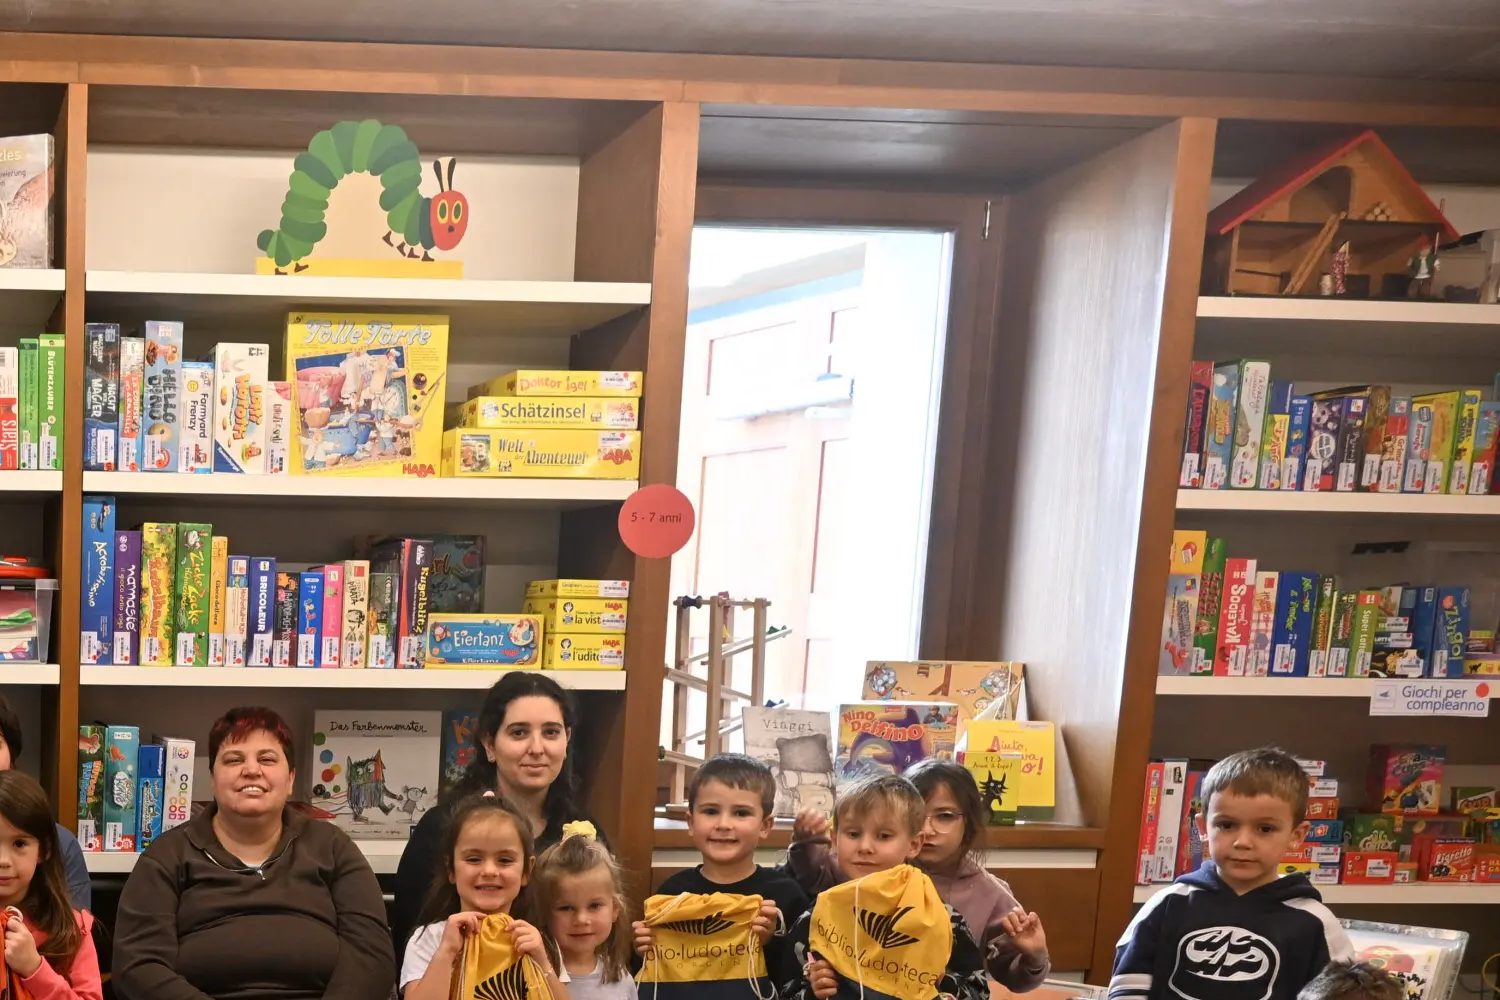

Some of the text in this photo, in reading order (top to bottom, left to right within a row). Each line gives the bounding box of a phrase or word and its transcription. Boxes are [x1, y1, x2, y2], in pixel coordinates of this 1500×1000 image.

[303, 320, 432, 345] Tolle Torte
[519, 376, 562, 391] Doktor
[91, 379, 102, 417] MAGIER
[107, 383, 116, 411] NACHT
[162, 368, 177, 423] HELLO
[188, 400, 199, 431] Frenzy
[199, 392, 209, 438] Farmyard
[501, 402, 586, 419] Schätzinsel
[498, 438, 525, 454] Welt
[523, 450, 589, 465] Abenteuer
[402, 463, 436, 478] HABA
[630, 512, 638, 522] 5
[649, 512, 656, 522] 7
[659, 512, 682, 523] anni
[257, 575, 269, 632] BRICOLEUR
[574, 615, 601, 625] la vist
[1225, 584, 1248, 644] KALEIDOS
[1360, 609, 1372, 632] Super
[454, 630, 505, 647] Eiertanz
[1402, 685, 1468, 701] Giochi per
[1406, 698, 1485, 713] compleanno
[762, 718, 814, 733] Viaggi
[842, 708, 876, 726] Nino
[330, 720, 428, 733] Das Farbenmonster
[850, 719, 925, 742] Delfino
[179, 773, 189, 821] COLOUR
